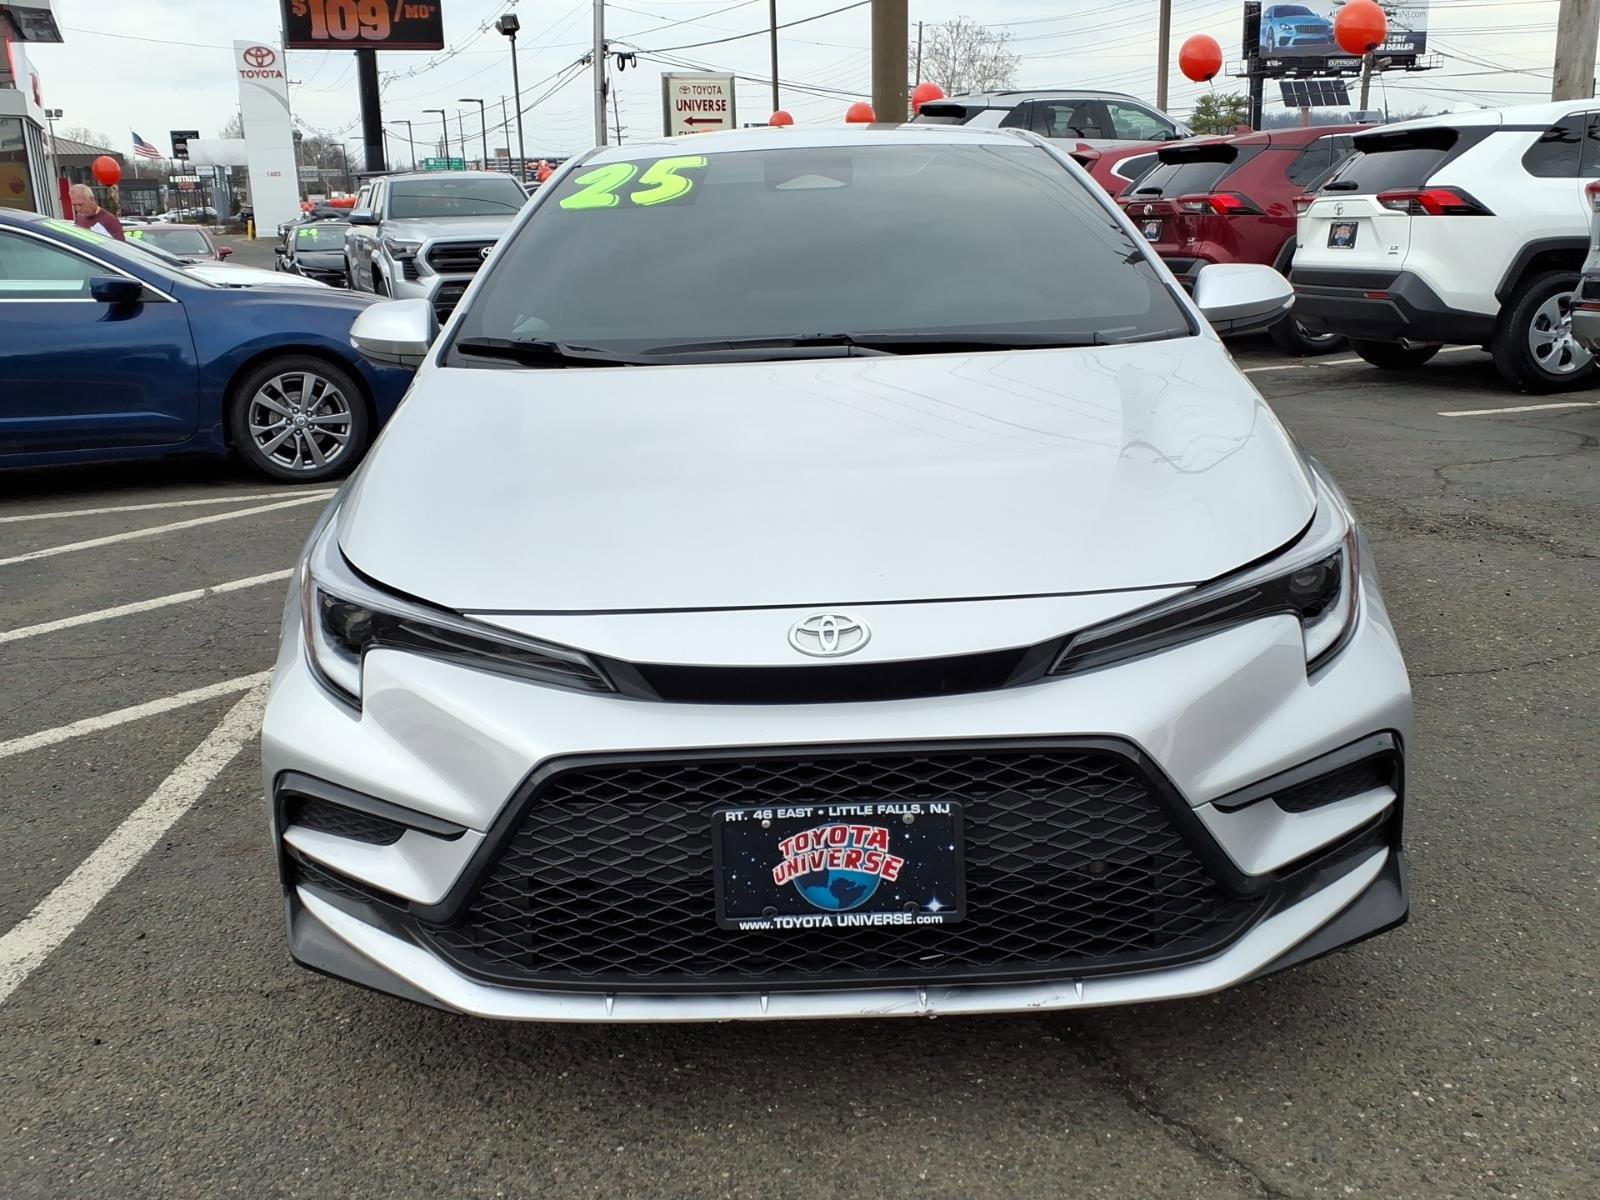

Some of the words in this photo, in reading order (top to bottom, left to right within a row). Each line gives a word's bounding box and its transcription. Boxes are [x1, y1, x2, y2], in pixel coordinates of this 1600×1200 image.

[1386, 43, 1415, 51] DEALER
[239, 69, 283, 79] TOYOTA
[692, 85, 722, 95] TOYOTA
[675, 99, 727, 112] UNIVERSE
[560, 156, 708, 209] 25
[725, 811, 748, 822] RT.
[753, 809, 772, 820] 46
[777, 807, 814, 819] EAST
[829, 805, 873, 816] LITTLE
[877, 803, 925, 815] FALLS,
[929, 803, 950, 814] NJ
[778, 824, 889, 860] TOYOTA
[772, 847, 905, 886] UNIVERSE
[739, 916, 833, 930] www.TOYOTA
[837, 912, 943, 927] UNIVERSE.com
